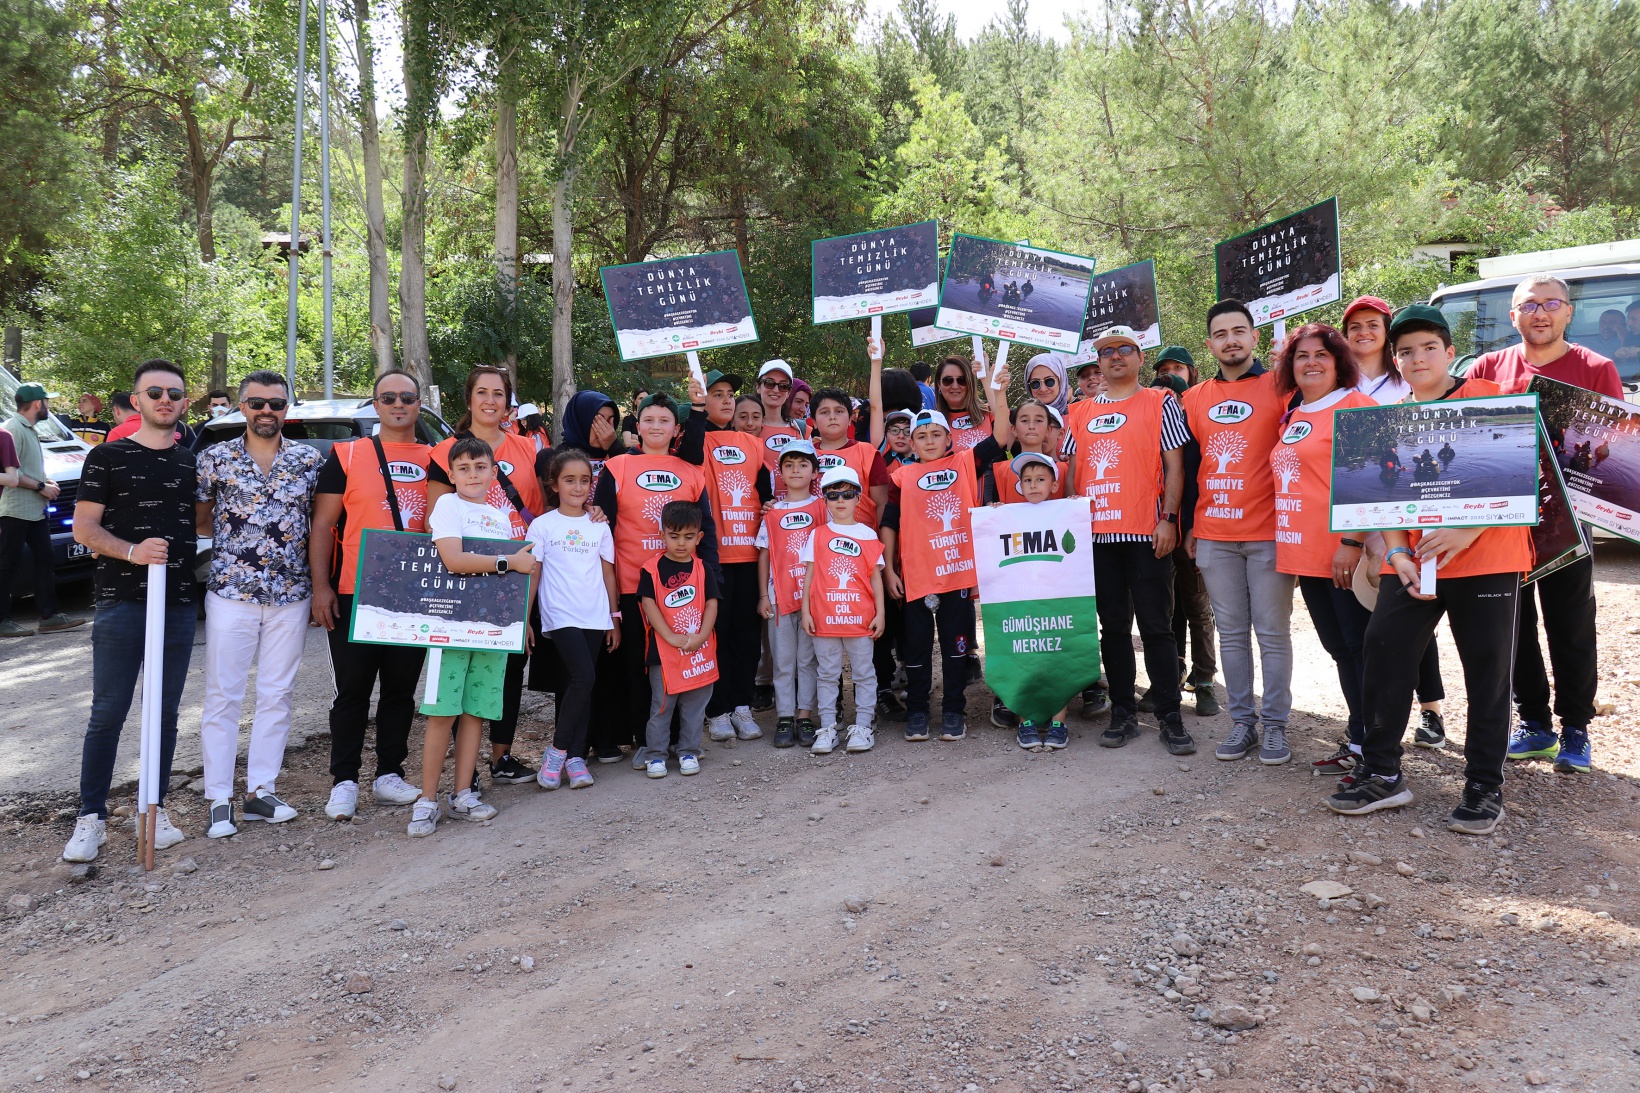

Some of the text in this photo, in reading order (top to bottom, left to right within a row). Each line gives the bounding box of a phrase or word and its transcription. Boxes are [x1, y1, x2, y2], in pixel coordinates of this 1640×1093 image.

[852, 238, 895, 252] DÜNYA
[1253, 227, 1294, 250] DÜNYA
[840, 247, 907, 265] TEMİZLİK
[1009, 250, 1045, 263] DÜNYA
[1242, 236, 1307, 268] TEMİZLİK
[857, 260, 890, 274] GÜNÜ
[997, 257, 1052, 274] TEMİZLİK
[1258, 254, 1291, 275] GÜNÜ
[647, 267, 695, 281] DÜNYA
[1009, 269, 1038, 281] GÜNÜ
[637, 278, 711, 296] TEMİZLİK
[1094, 281, 1116, 293] NYA
[659, 293, 696, 306] GÜNÜ
[1087, 289, 1127, 307] İZLİK
[1218, 404, 1239, 415] TEMA
[1412, 409, 1463, 421] DÜNYA
[1589, 401, 1632, 421] DÜNYA
[1096, 416, 1115, 426] TEMA
[1399, 420, 1476, 434] TEMİZLİK
[1574, 410, 1639, 437] TEMİZLİK
[1290, 424, 1305, 437] TEMA
[1585, 426, 1618, 443] GÜNÜ
[1417, 433, 1457, 444] GÜNÜ
[719, 449, 738, 457] TEMA
[390, 464, 414, 475] TEMA
[646, 474, 671, 483] TEMA
[926, 472, 948, 485] TEMA
[1205, 475, 1244, 491] TÜRKİYE
[1086, 480, 1121, 497] TÜRKİYE
[1095, 492, 1109, 510] ÇÖL
[1213, 490, 1229, 505] ÇÖL
[721, 509, 754, 521] TÜRKİYE
[786, 515, 804, 523] TEMA
[1091, 510, 1122, 522] LMASIN
[1205, 507, 1243, 519] OLMASIN
[1278, 513, 1290, 528] ÇÖL
[732, 522, 747, 535] ÇÖL
[722, 536, 755, 546] OLMASIN
[836, 539, 854, 550] TEMA
[929, 531, 968, 550] TÜRKİYE
[1000, 529, 1058, 556] TEMA
[1275, 531, 1302, 545] LMASIN
[73, 544, 84, 555] 29
[944, 548, 961, 563] ÇÖL
[936, 558, 974, 577] OLMASIN
[421, 578, 466, 590] GÜNÜ
[671, 589, 689, 601] TEMA
[826, 591, 860, 602] TÜRKİYE
[835, 602, 851, 616] ÇÖL
[826, 616, 862, 625] OLMASIN
[1002, 615, 1074, 635] GÜMÜŞHANE
[1013, 637, 1062, 653] MERKEZ
[690, 652, 706, 666] ÇÖL
[682, 660, 715, 679] OLMASIN
